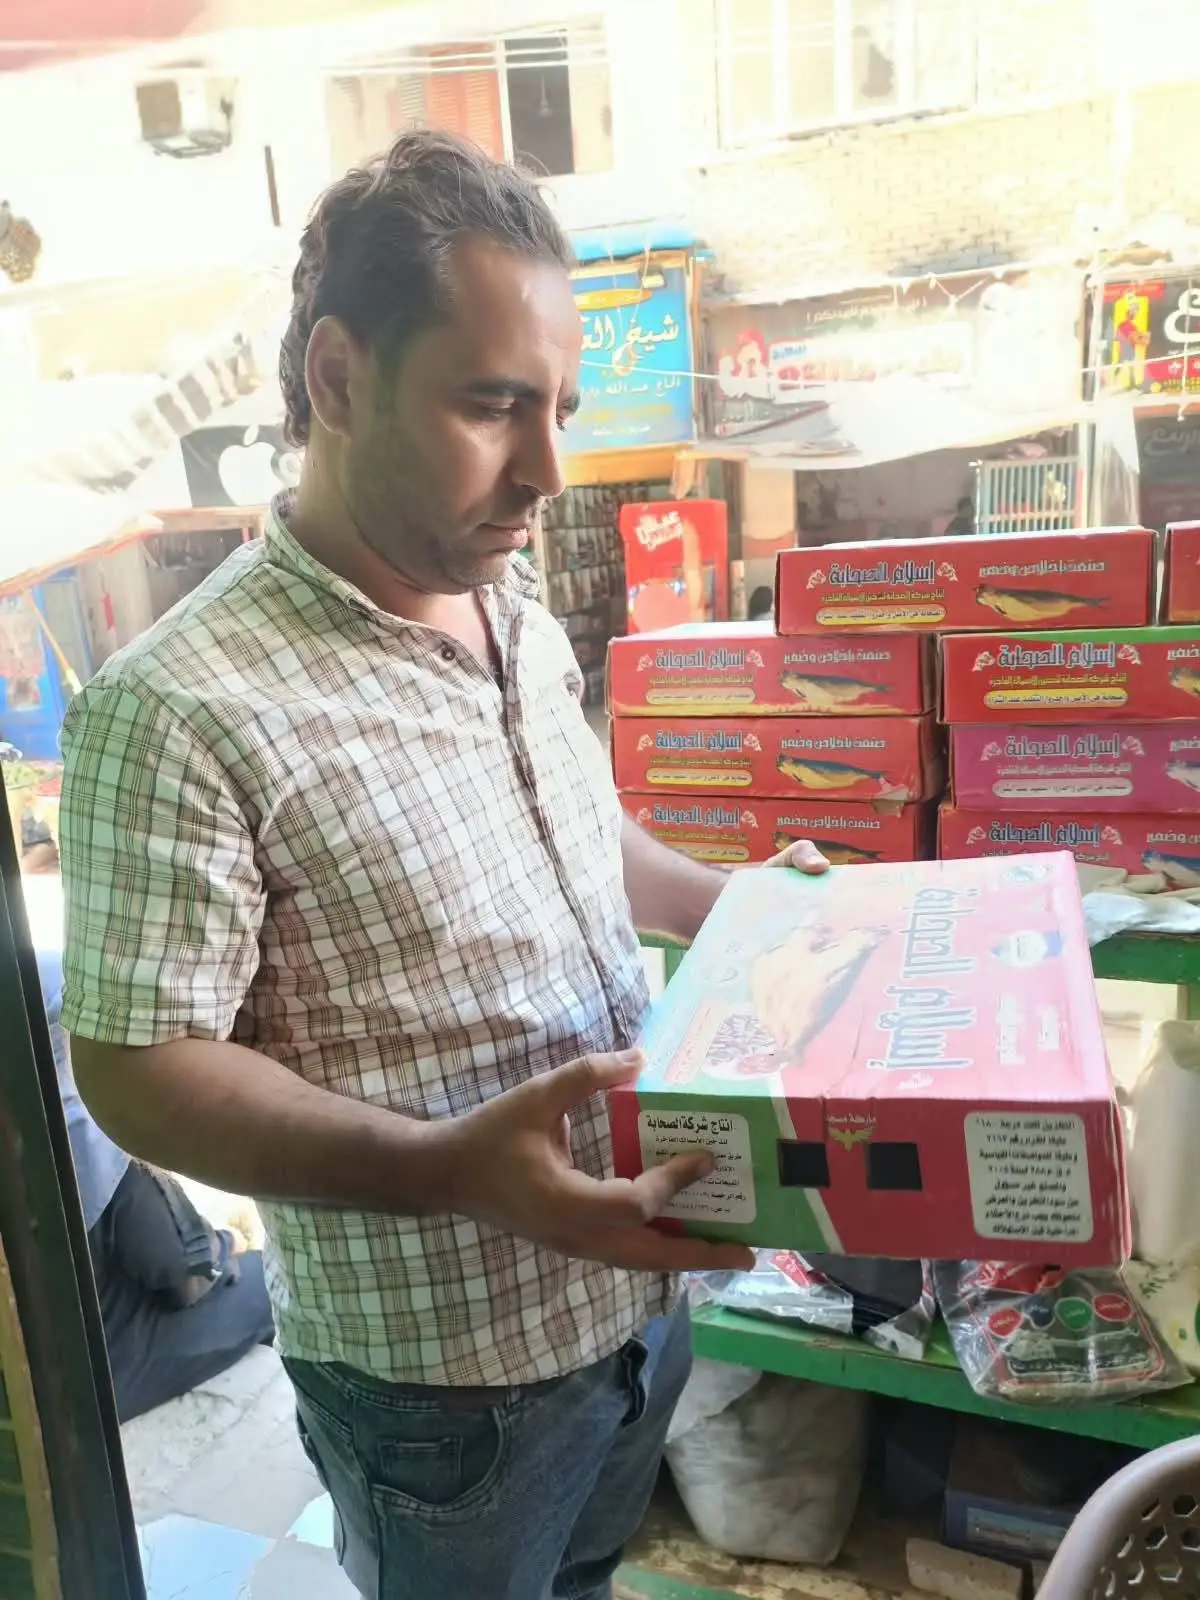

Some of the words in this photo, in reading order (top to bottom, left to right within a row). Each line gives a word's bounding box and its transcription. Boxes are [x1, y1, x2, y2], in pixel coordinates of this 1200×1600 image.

[828, 562, 889, 588] الصحابة
[892, 559, 936, 586] إسلام
[655, 648, 705, 670] الصحابة
[708, 648, 745, 670] إسلام
[997, 643, 1065, 670] الصحابة
[1066, 641, 1116, 669] إسلام
[655, 730, 704, 751] الصحابة
[707, 730, 743, 753] إسلام
[1005, 734, 1069, 760] الصحابة
[1072, 732, 1121, 759] إسلام
[652, 804, 702, 825] الصحابة
[703, 806, 740, 829] إسلام
[988, 819, 1052, 845] الصحابة
[1054, 819, 1100, 848] إسلام
[646, 1115, 682, 1132] الصحابة
[682, 1115, 709, 1134] شركة
